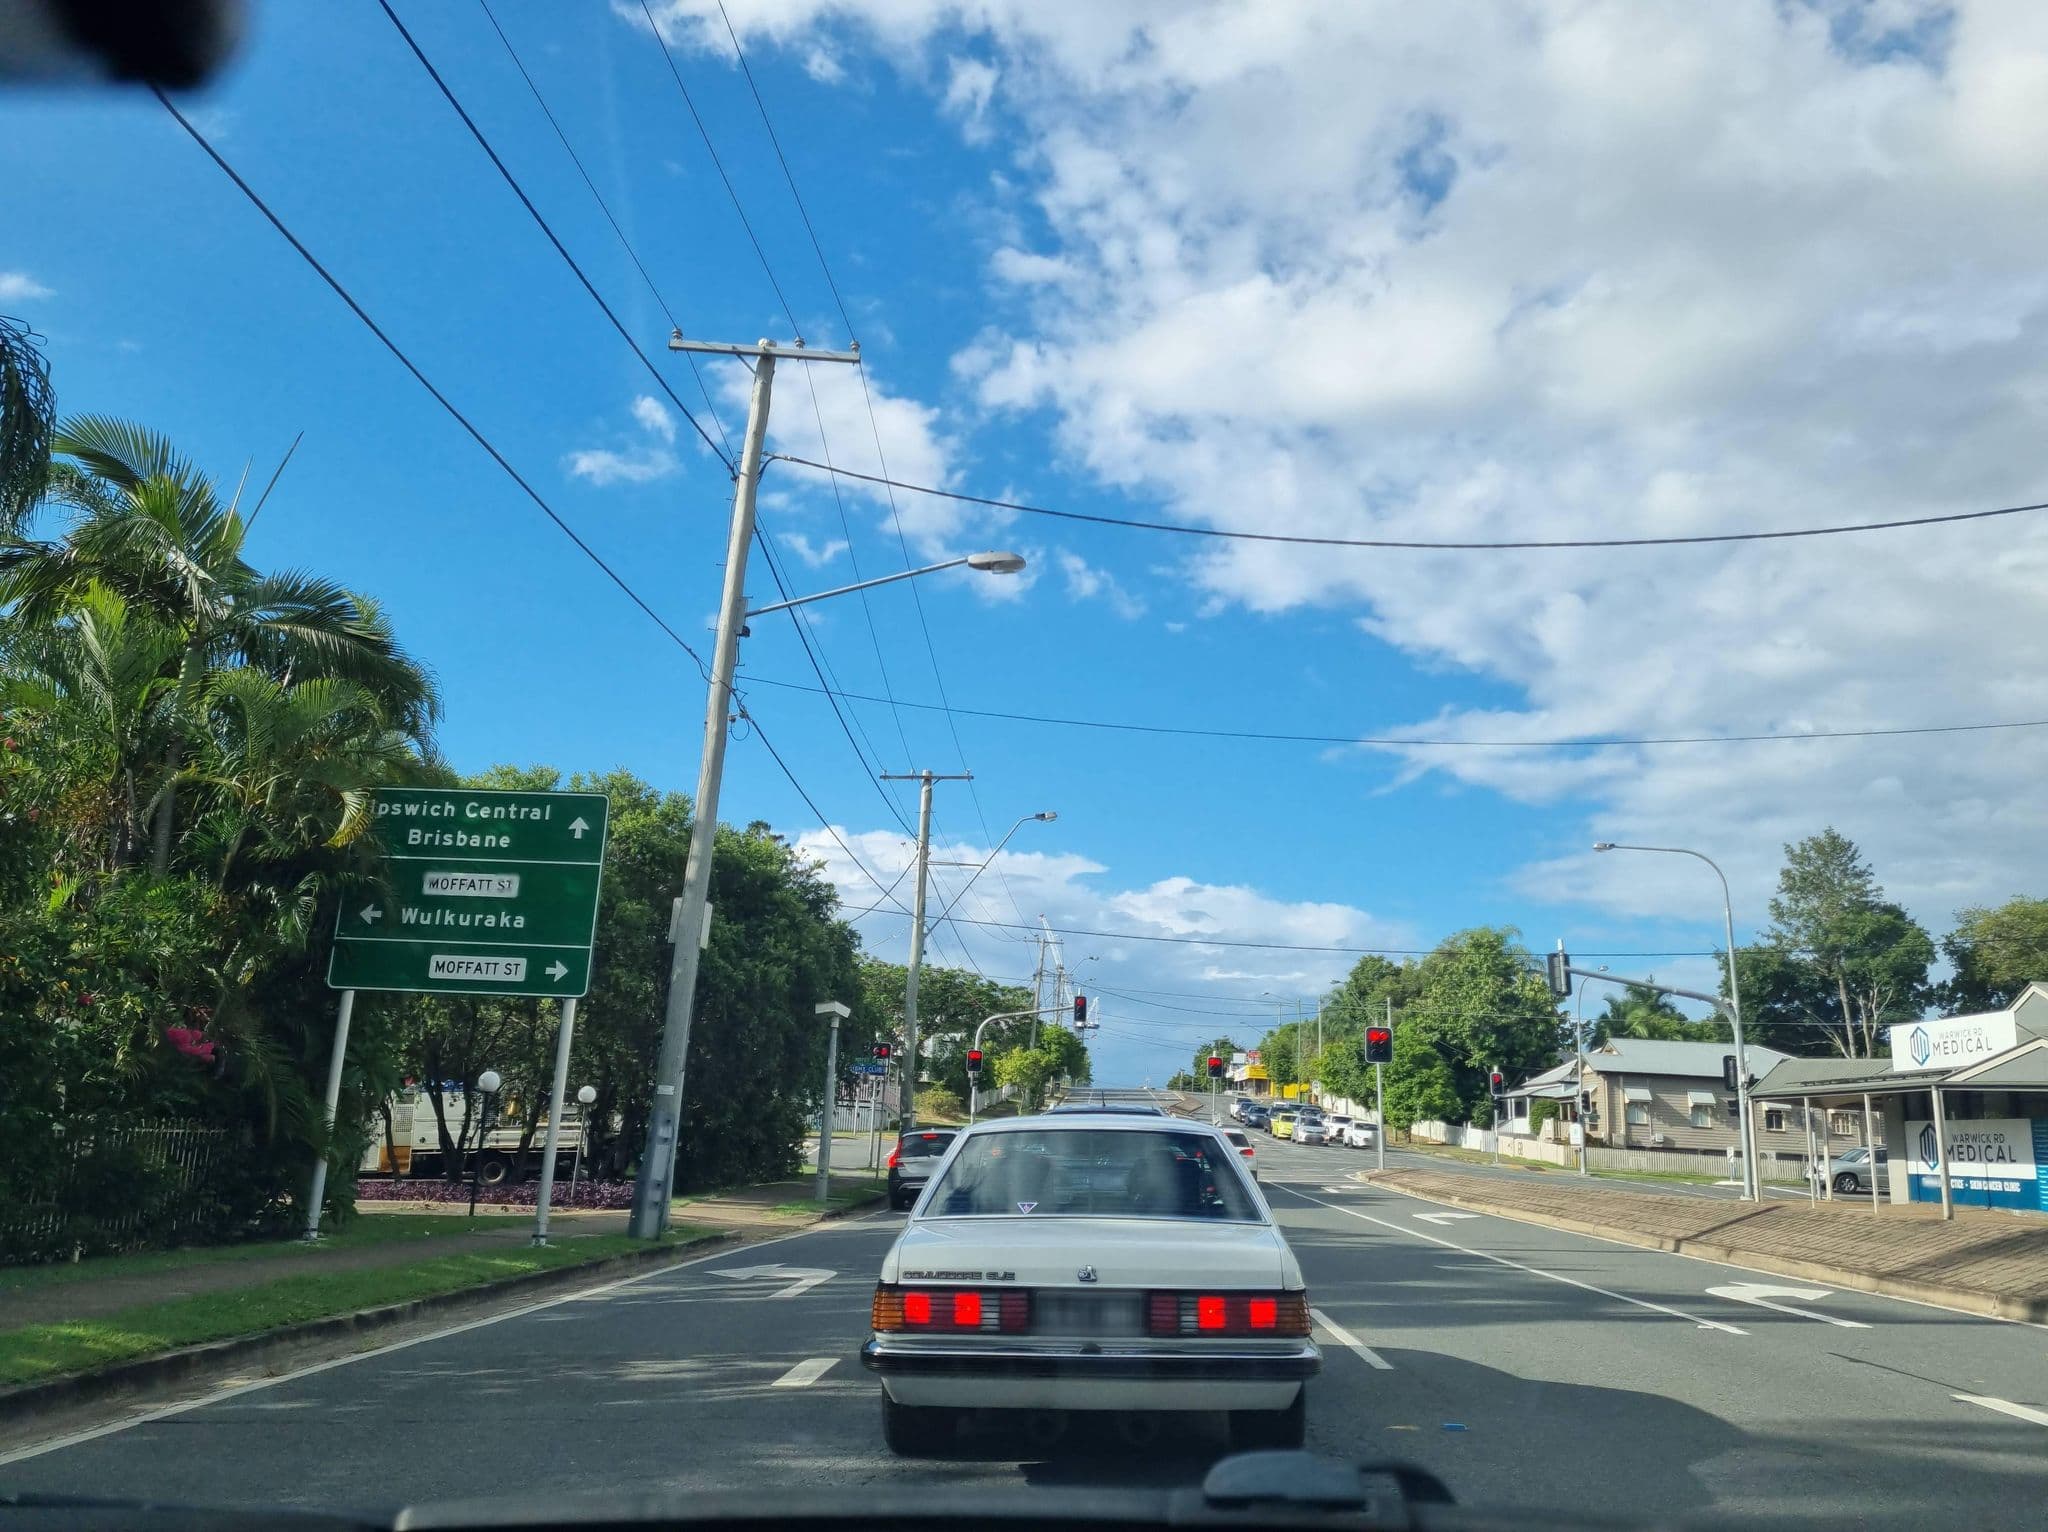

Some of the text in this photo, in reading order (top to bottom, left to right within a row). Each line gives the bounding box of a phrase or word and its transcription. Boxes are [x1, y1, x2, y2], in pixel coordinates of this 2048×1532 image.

[465, 802, 551, 821] Central
[407, 828, 511, 848] Brisbane
[429, 878, 512, 892] MOFFATT ST
[401, 907, 525, 929] Wulkuraka
[435, 960, 521, 976] MOFFATT ST
[1938, 1028, 1972, 1040] WARWICK
[1933, 1036, 1993, 1056] MEDICAL
[1952, 1133, 2005, 1144] WARWICK RD
[1946, 1144, 2017, 1162] MEDICAL
